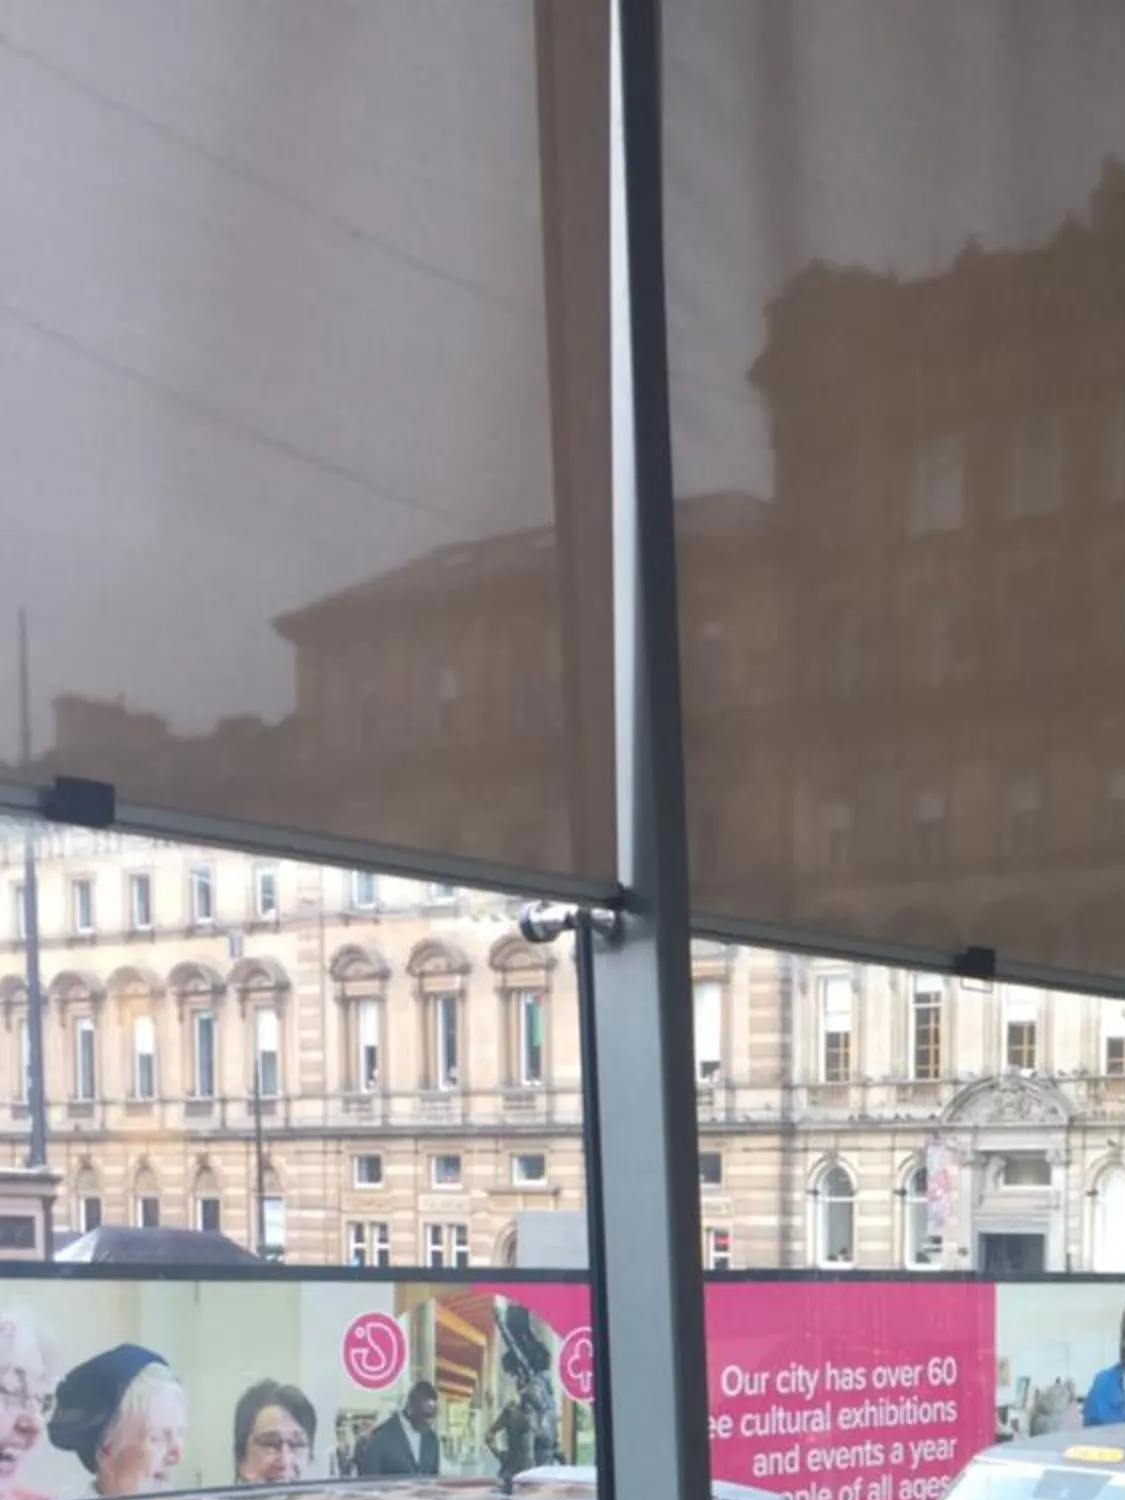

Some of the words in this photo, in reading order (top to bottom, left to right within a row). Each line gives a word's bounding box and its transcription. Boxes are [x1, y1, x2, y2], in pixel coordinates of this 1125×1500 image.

[721, 1364, 769, 1397] Our
[776, 1363, 820, 1401] city
[825, 1361, 867, 1392] has
[872, 1364, 924, 1390] over
[927, 1357, 957, 1387] 60
[707, 1414, 733, 1439] ee
[740, 1402, 831, 1437] cultural
[838, 1398, 958, 1431] exhibitions
[753, 1445, 799, 1478] and
[807, 1440, 884, 1473] events
[890, 1442, 904, 1465] a
[910, 1436, 958, 1470] year
